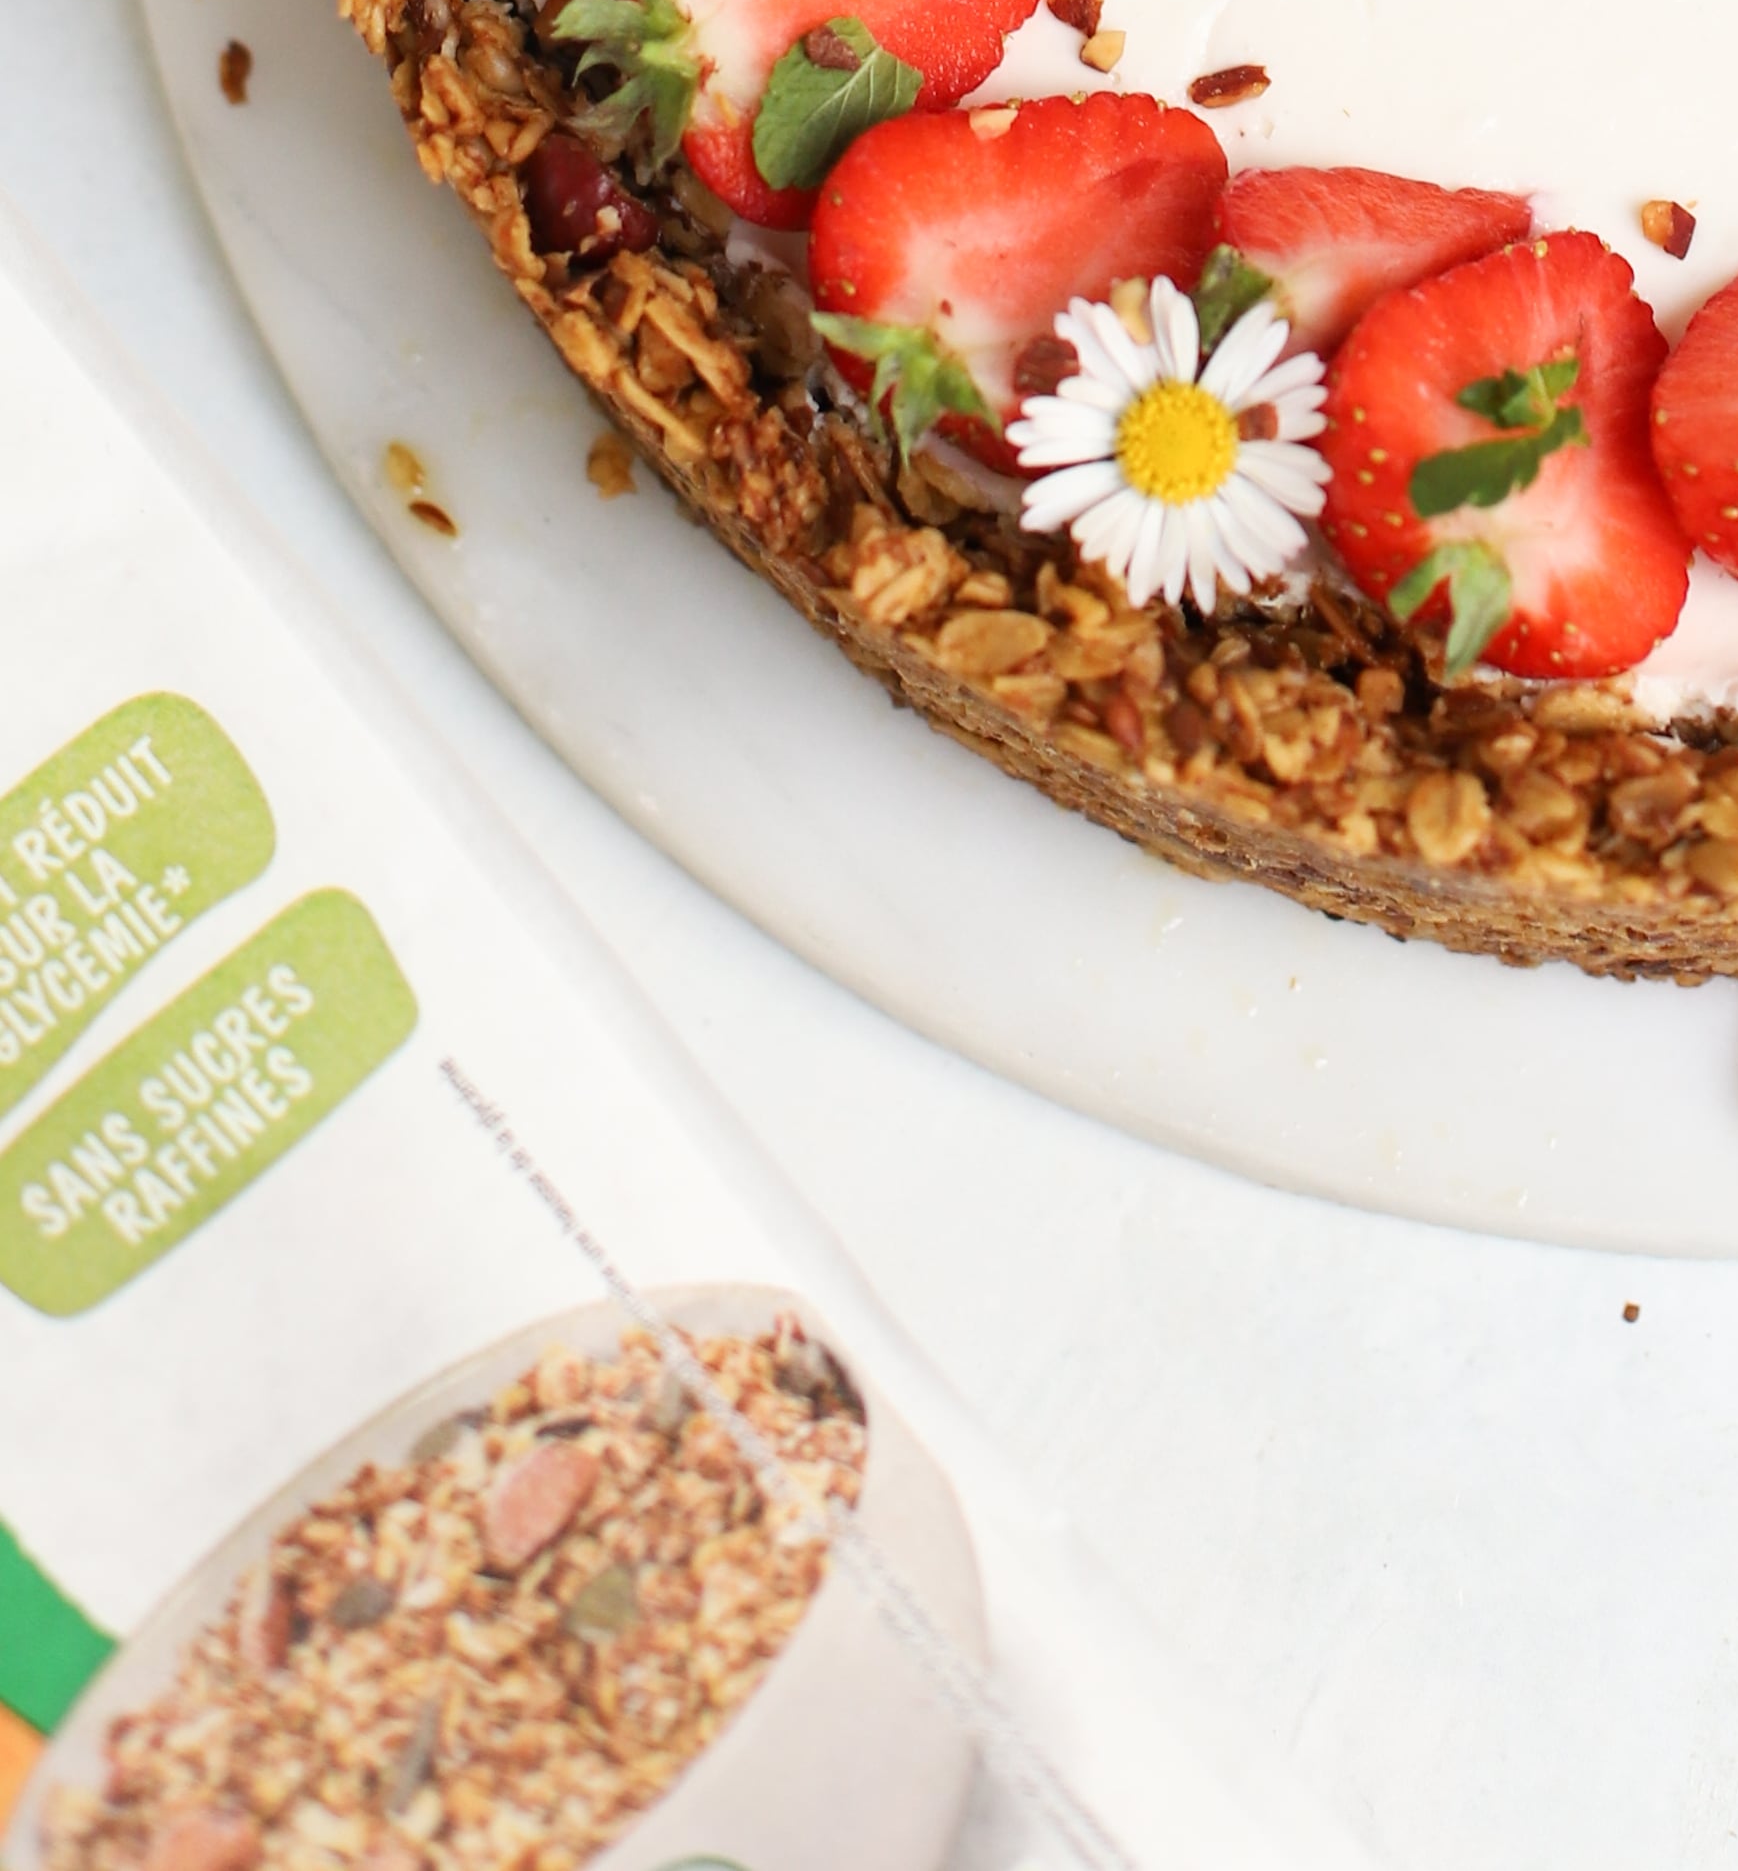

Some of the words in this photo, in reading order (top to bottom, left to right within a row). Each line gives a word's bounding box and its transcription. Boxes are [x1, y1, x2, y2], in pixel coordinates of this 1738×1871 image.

[12, 734, 172, 881] RÉDUIT
[64, 847, 137, 916] LA
[21, 1111, 149, 1237] SANS
[139, 963, 314, 1129] SUCRES
